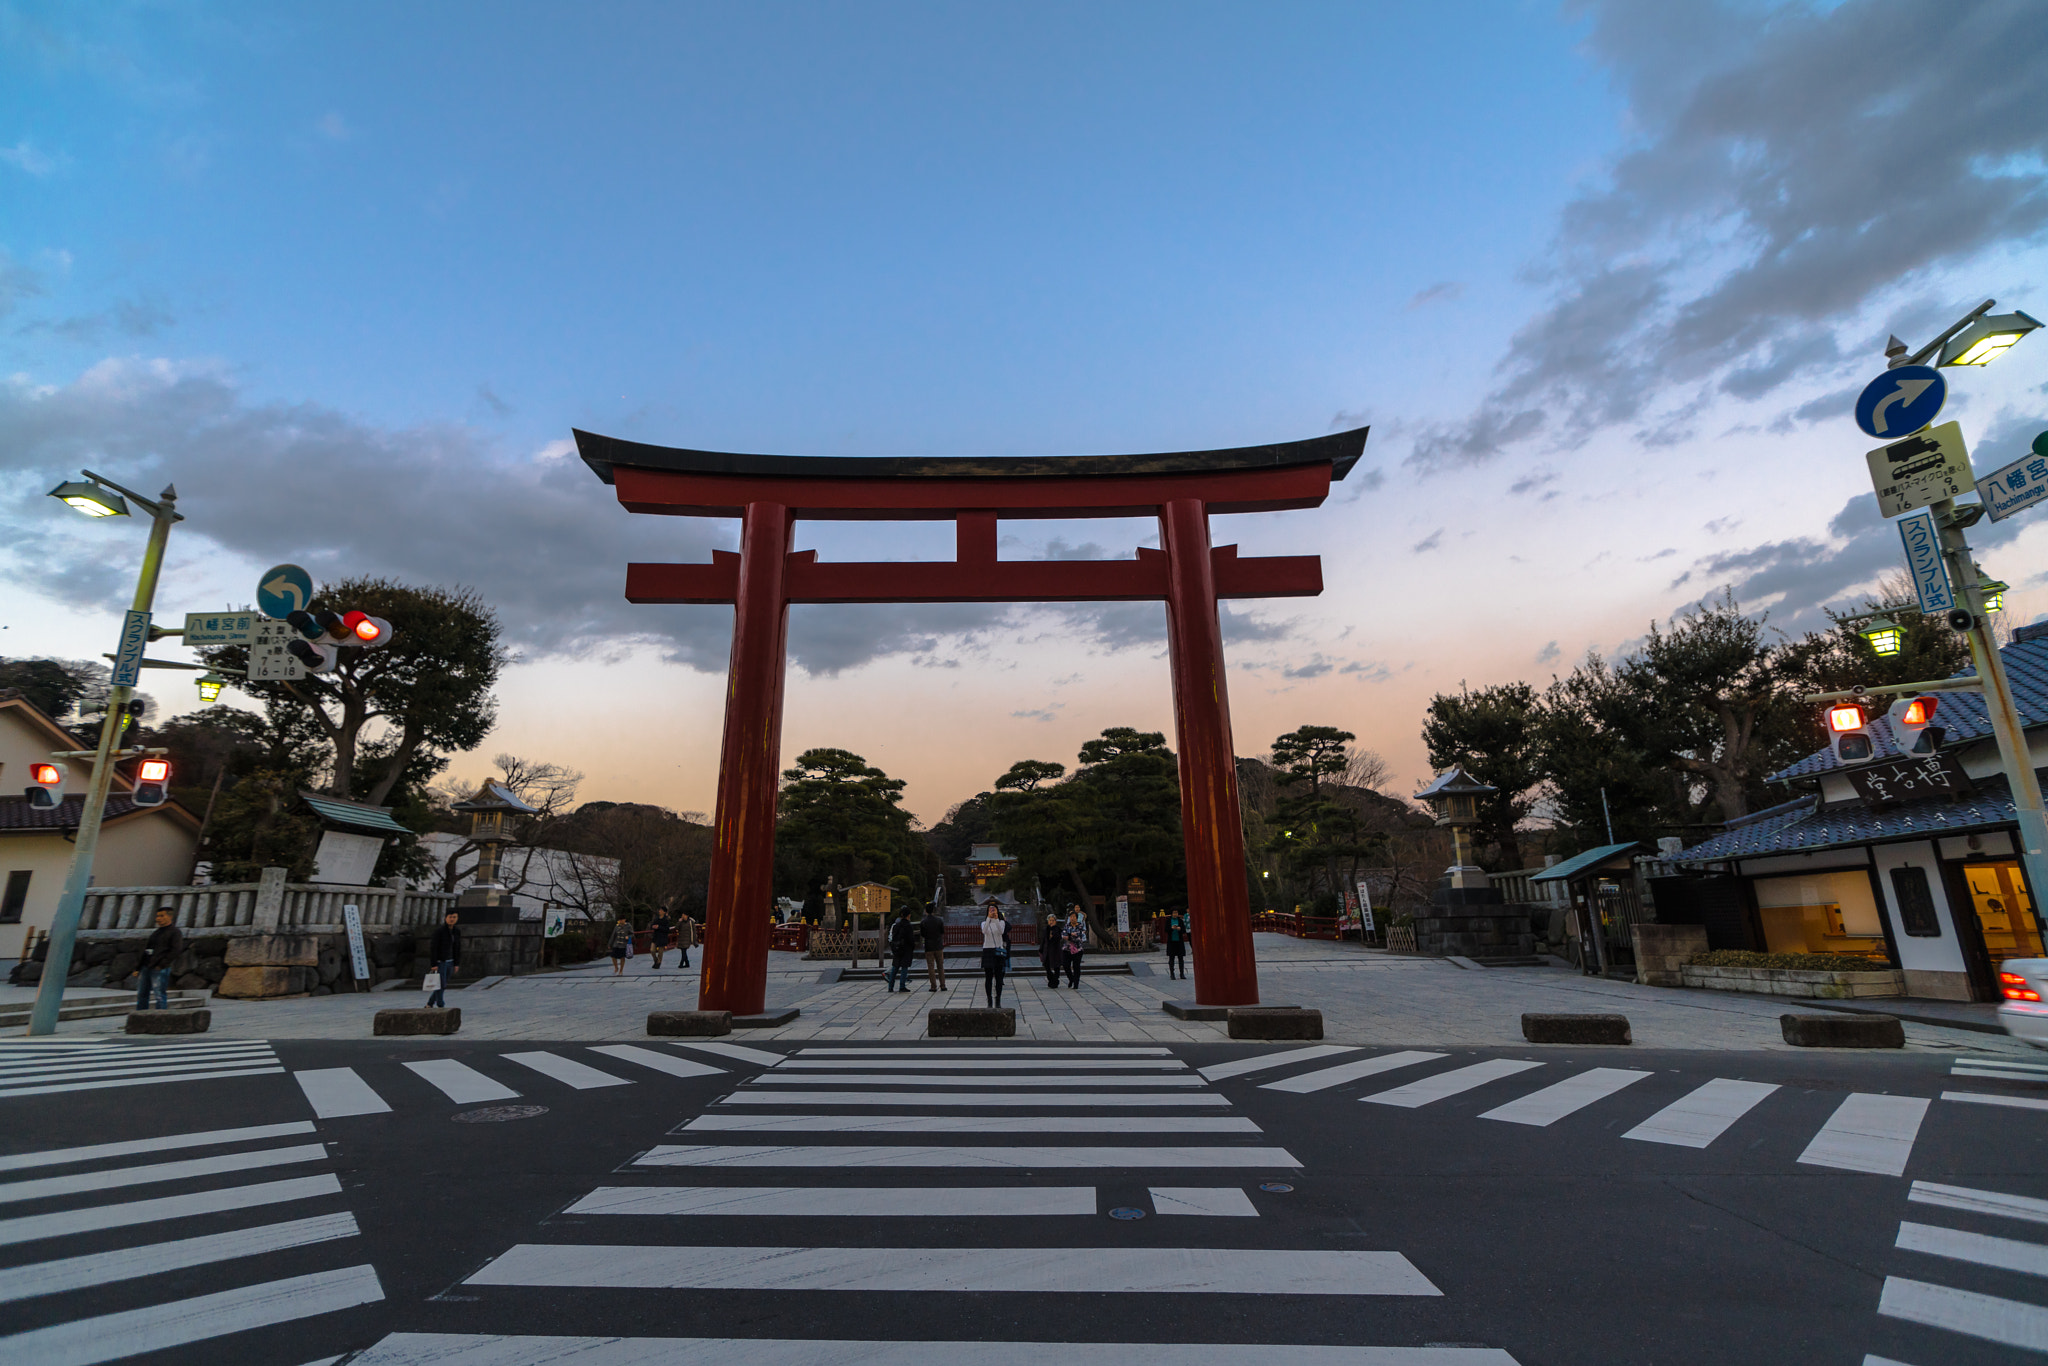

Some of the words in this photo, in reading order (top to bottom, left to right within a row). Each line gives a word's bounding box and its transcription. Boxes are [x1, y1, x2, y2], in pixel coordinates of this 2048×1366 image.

[1896, 493, 1905, 502] 7
[1944, 477, 1953, 486] 9
[1896, 501, 1912, 512] 16
[1943, 485, 1959, 497] 18
[1995, 484, 2046, 512] Hachimangu
[1907, 520, 1947, 608] スクランブル式
[190, 617, 250, 631] 八幡宮前
[117, 614, 144, 683] スクランブル式
[261, 656, 268, 665] 7
[288, 656, 295, 665] 9
[257, 667, 268, 676] 16
[284, 667, 295, 676] 18
